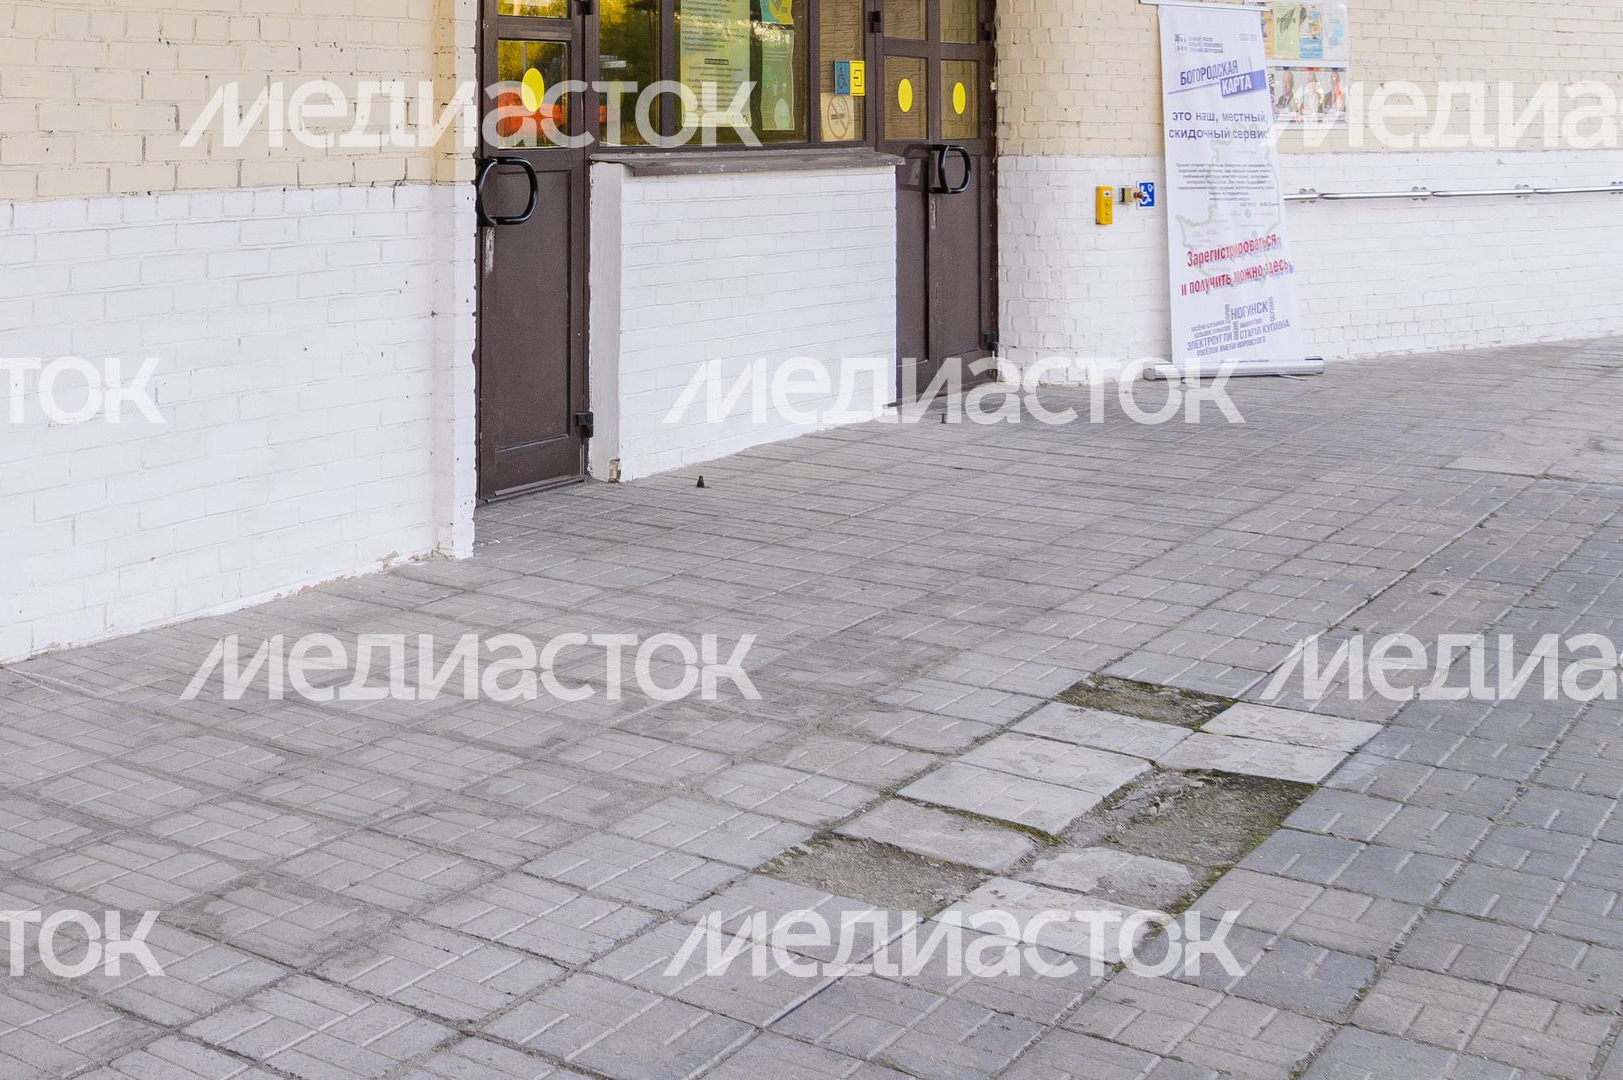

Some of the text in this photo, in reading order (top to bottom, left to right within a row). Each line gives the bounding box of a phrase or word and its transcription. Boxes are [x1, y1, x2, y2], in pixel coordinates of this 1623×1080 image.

[1180, 60, 1238, 86] БОГОРОДСКАЯ
[1223, 74, 1252, 95] КАРТА
[1195, 112, 1219, 123] наш,
[1222, 110, 1268, 124] местный,
[1169, 127, 1230, 140] скидочный
[1186, 233, 1277, 269] Зарегистрироваться
[1181, 283, 1187, 296] и
[1189, 273, 1232, 295] получить
[1232, 264, 1262, 284] можно
[1231, 300, 1268, 320] НОГИНСК
